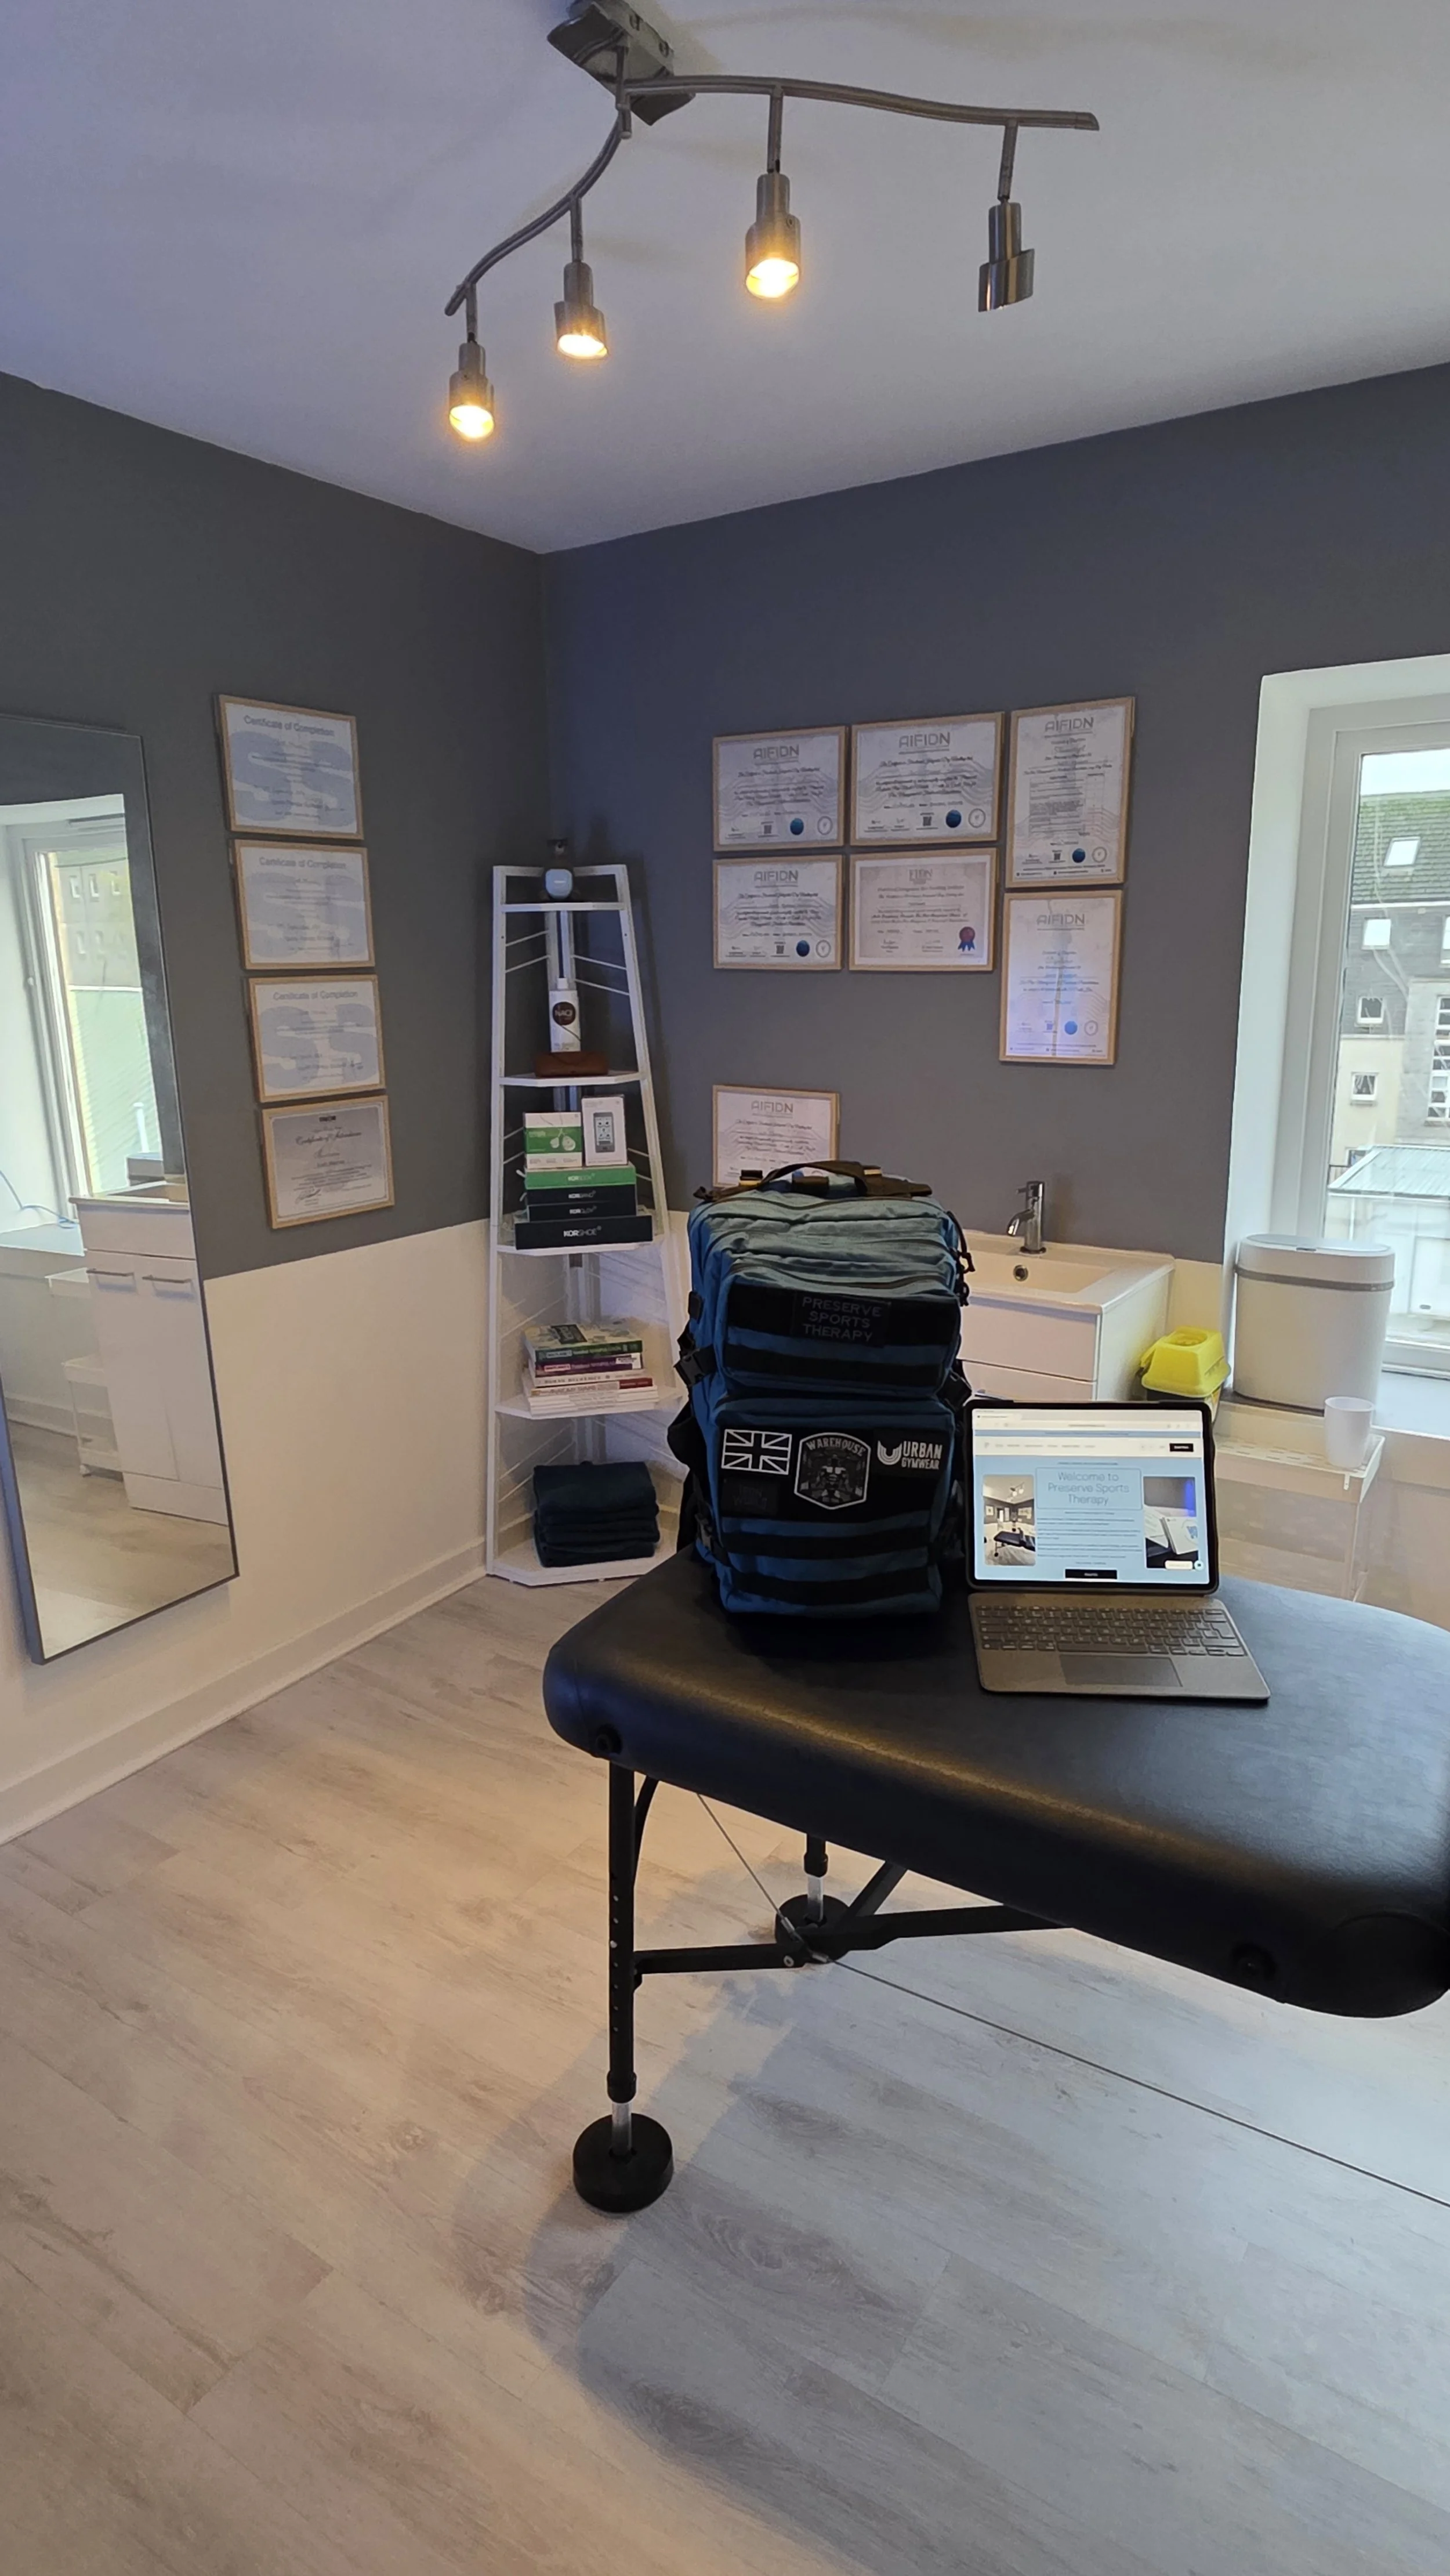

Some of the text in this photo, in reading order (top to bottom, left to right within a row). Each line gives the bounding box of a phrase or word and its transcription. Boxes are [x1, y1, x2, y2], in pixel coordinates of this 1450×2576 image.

[802, 1297, 882, 1317] PRESERVE
[809, 1311, 871, 1329] SPORTS
[802, 1323, 873, 1342] THERAPY
[806, 1437, 867, 1457] WAREHOUSE
[902, 1440, 942, 1460] URBAN
[901, 1457, 940, 1470] GYMWEAR
[1057, 1471, 1119, 1482] Welcome to
[1047, 1482, 1130, 1495] Preserve Sports
[1068, 1493, 1109, 1506] Therapy
